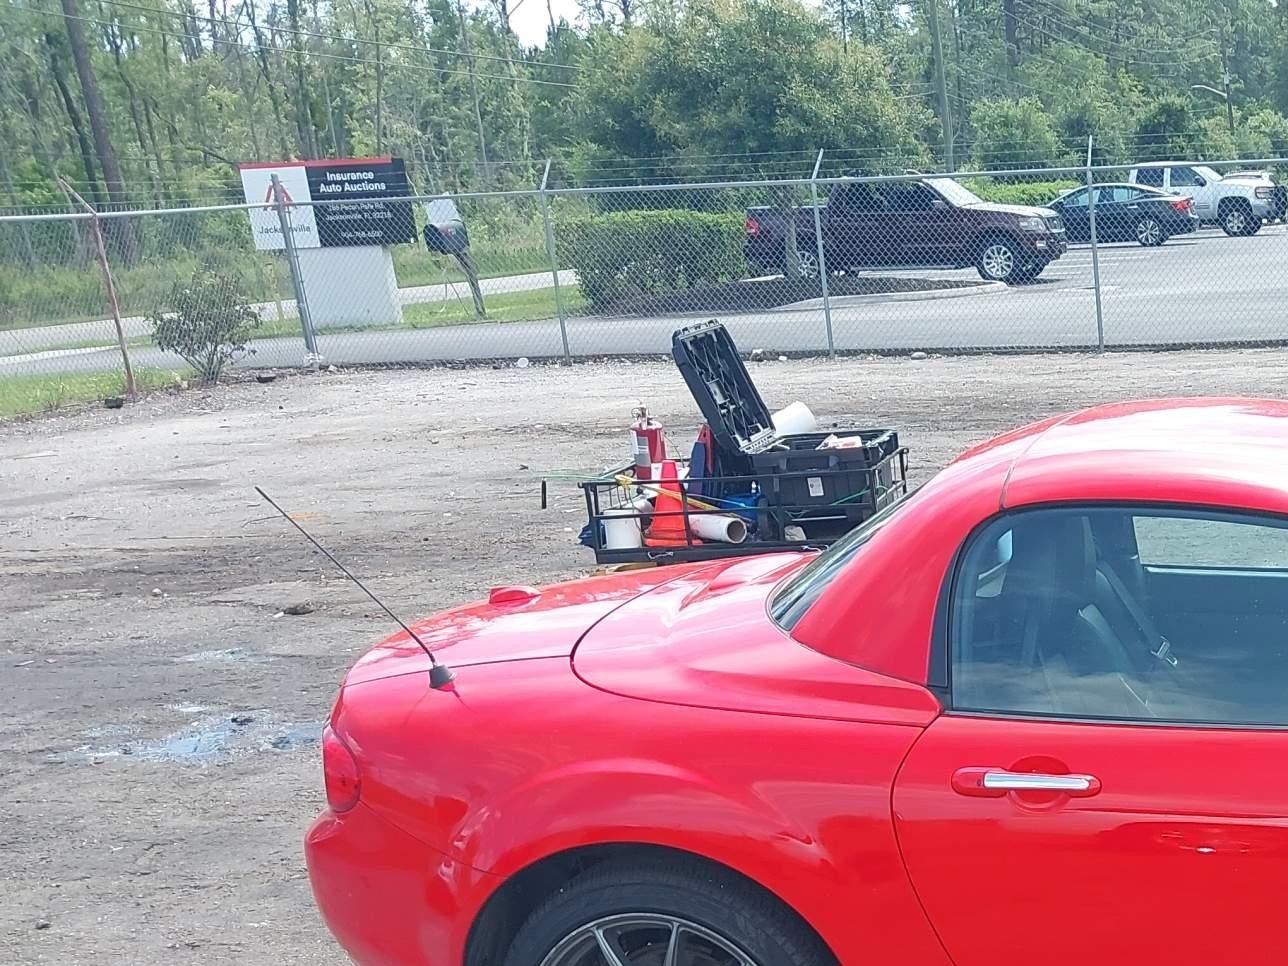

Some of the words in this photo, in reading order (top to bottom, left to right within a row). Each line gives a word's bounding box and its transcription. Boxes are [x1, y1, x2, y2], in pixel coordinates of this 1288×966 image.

[326, 171, 375, 181] Insurance
[320, 182, 342, 193] Auto
[344, 180, 387, 192] Auctions
